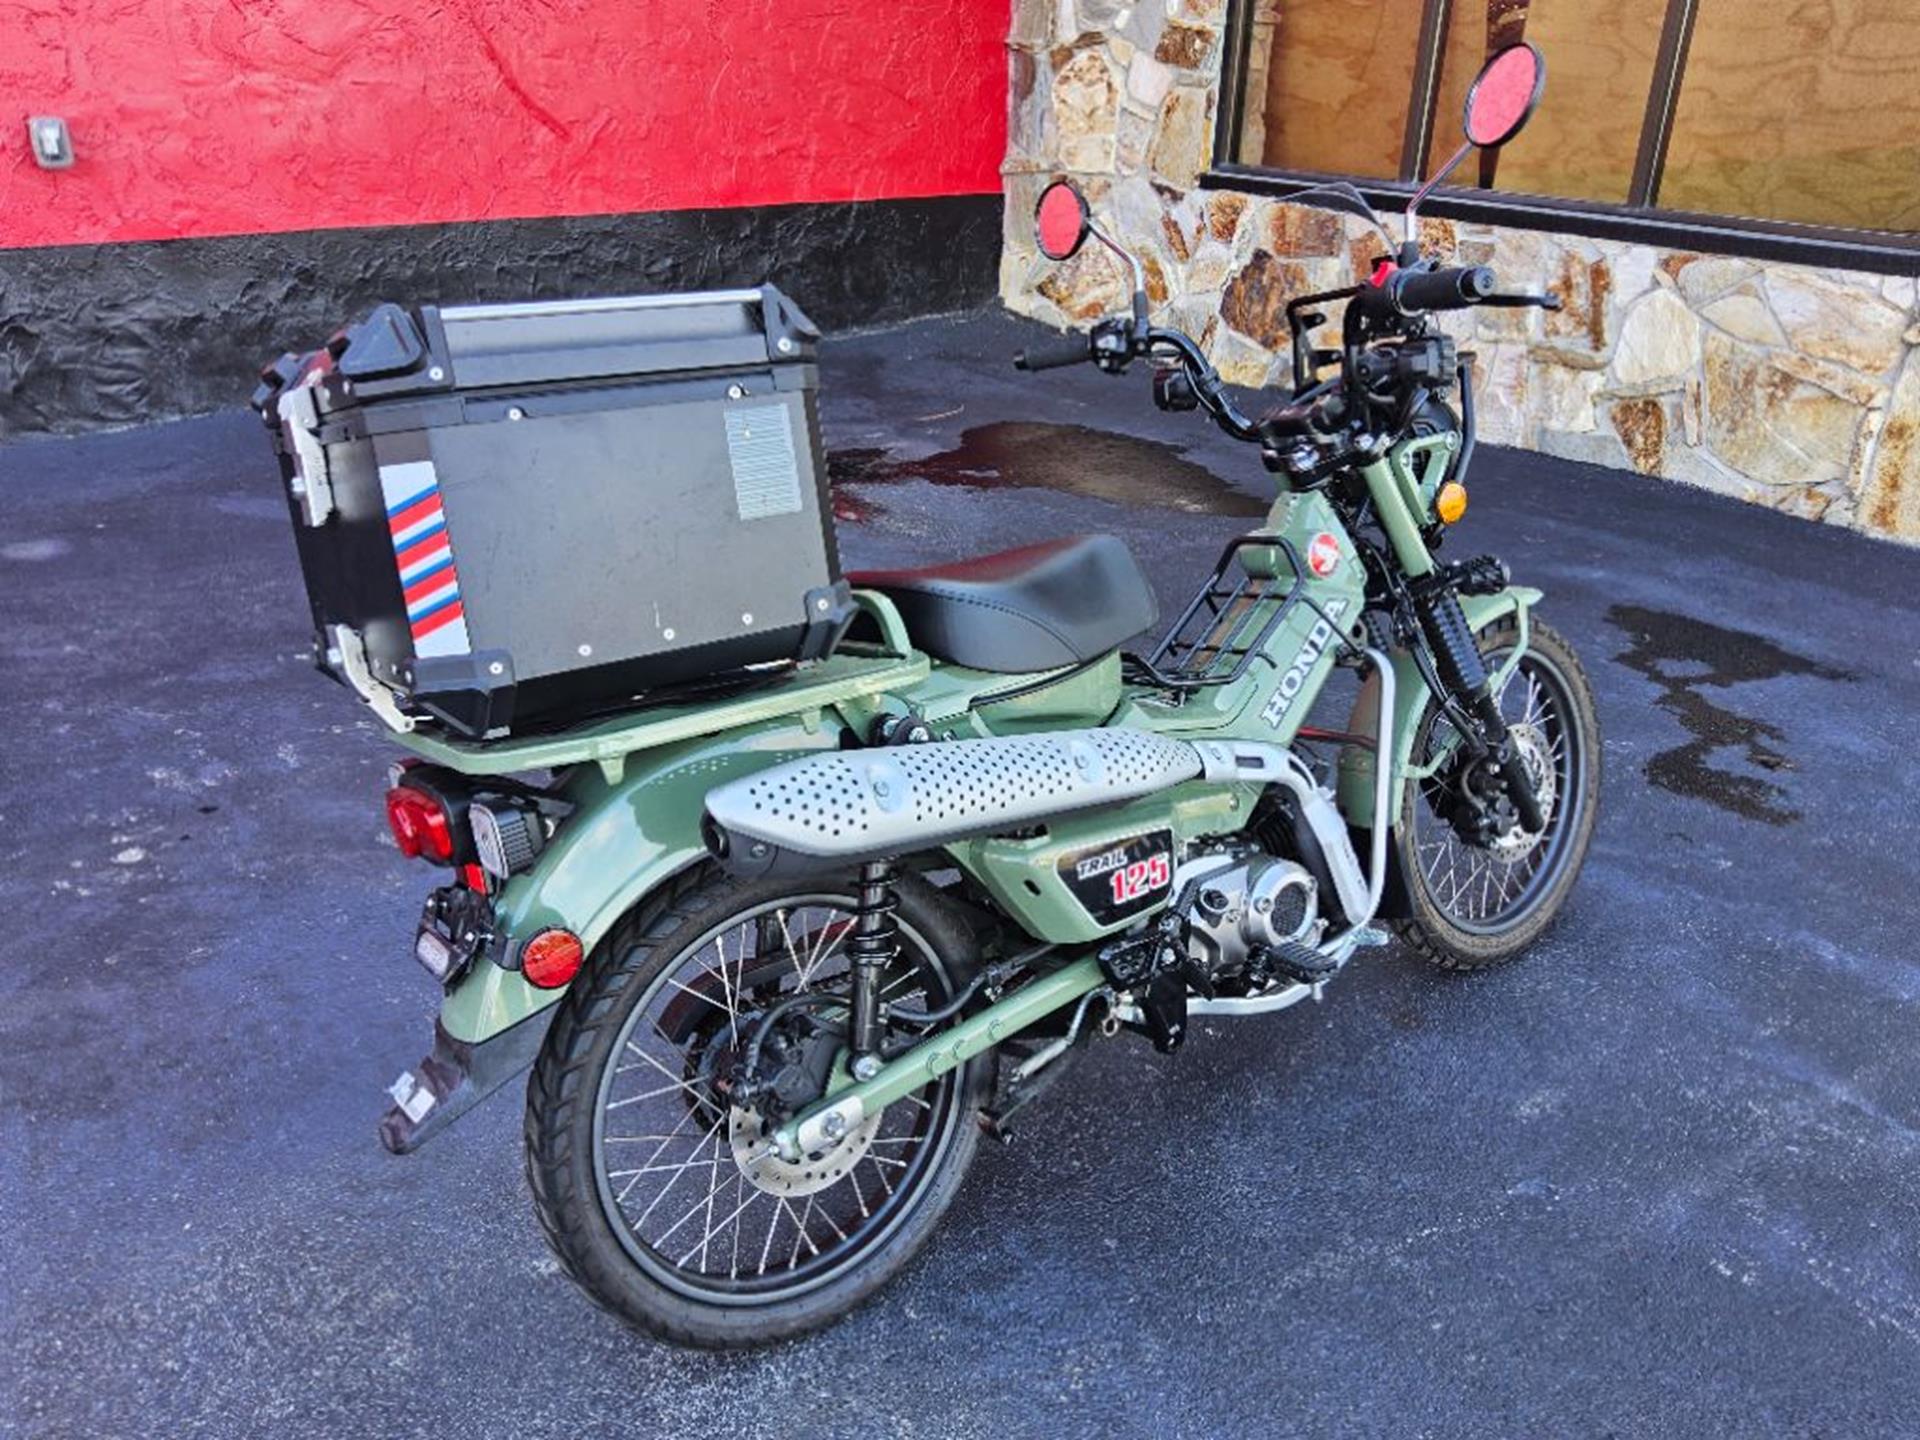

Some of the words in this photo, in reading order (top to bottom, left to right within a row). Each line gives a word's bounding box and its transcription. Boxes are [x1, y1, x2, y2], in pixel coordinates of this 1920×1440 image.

[1261, 599, 1349, 729] HONDA
[1076, 848, 1128, 881] TRAIL
[1110, 853, 1170, 905] 125
